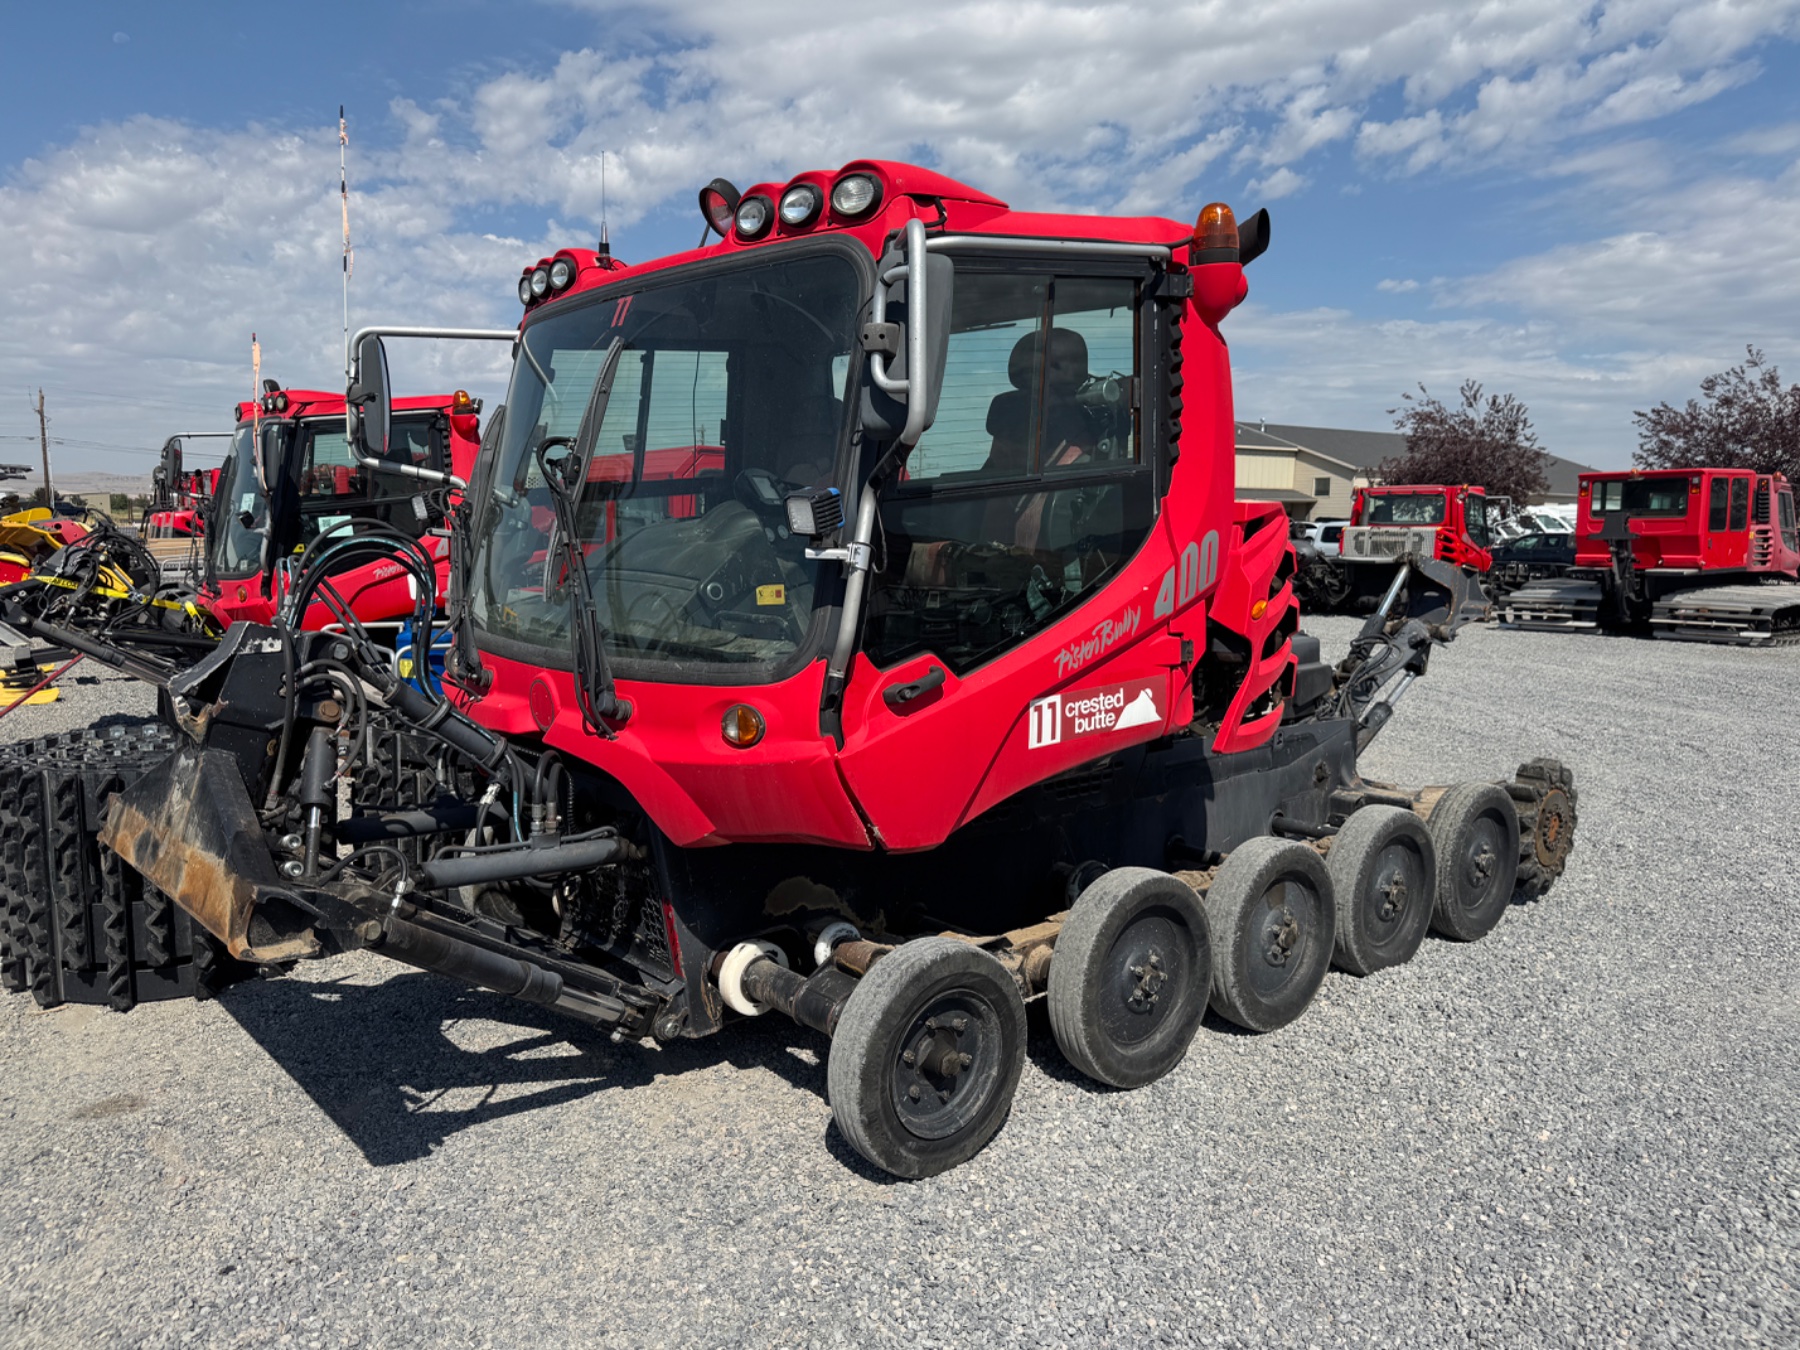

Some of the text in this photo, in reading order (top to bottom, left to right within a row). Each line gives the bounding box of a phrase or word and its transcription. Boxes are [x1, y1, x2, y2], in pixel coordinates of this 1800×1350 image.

[611, 295, 634, 328] 11
[1153, 529, 1220, 620] 400
[1053, 605, 1142, 679] PistenBully
[1065, 687, 1125, 718] crested
[1033, 700, 1058, 745] 11
[1074, 711, 1116, 734] butte
